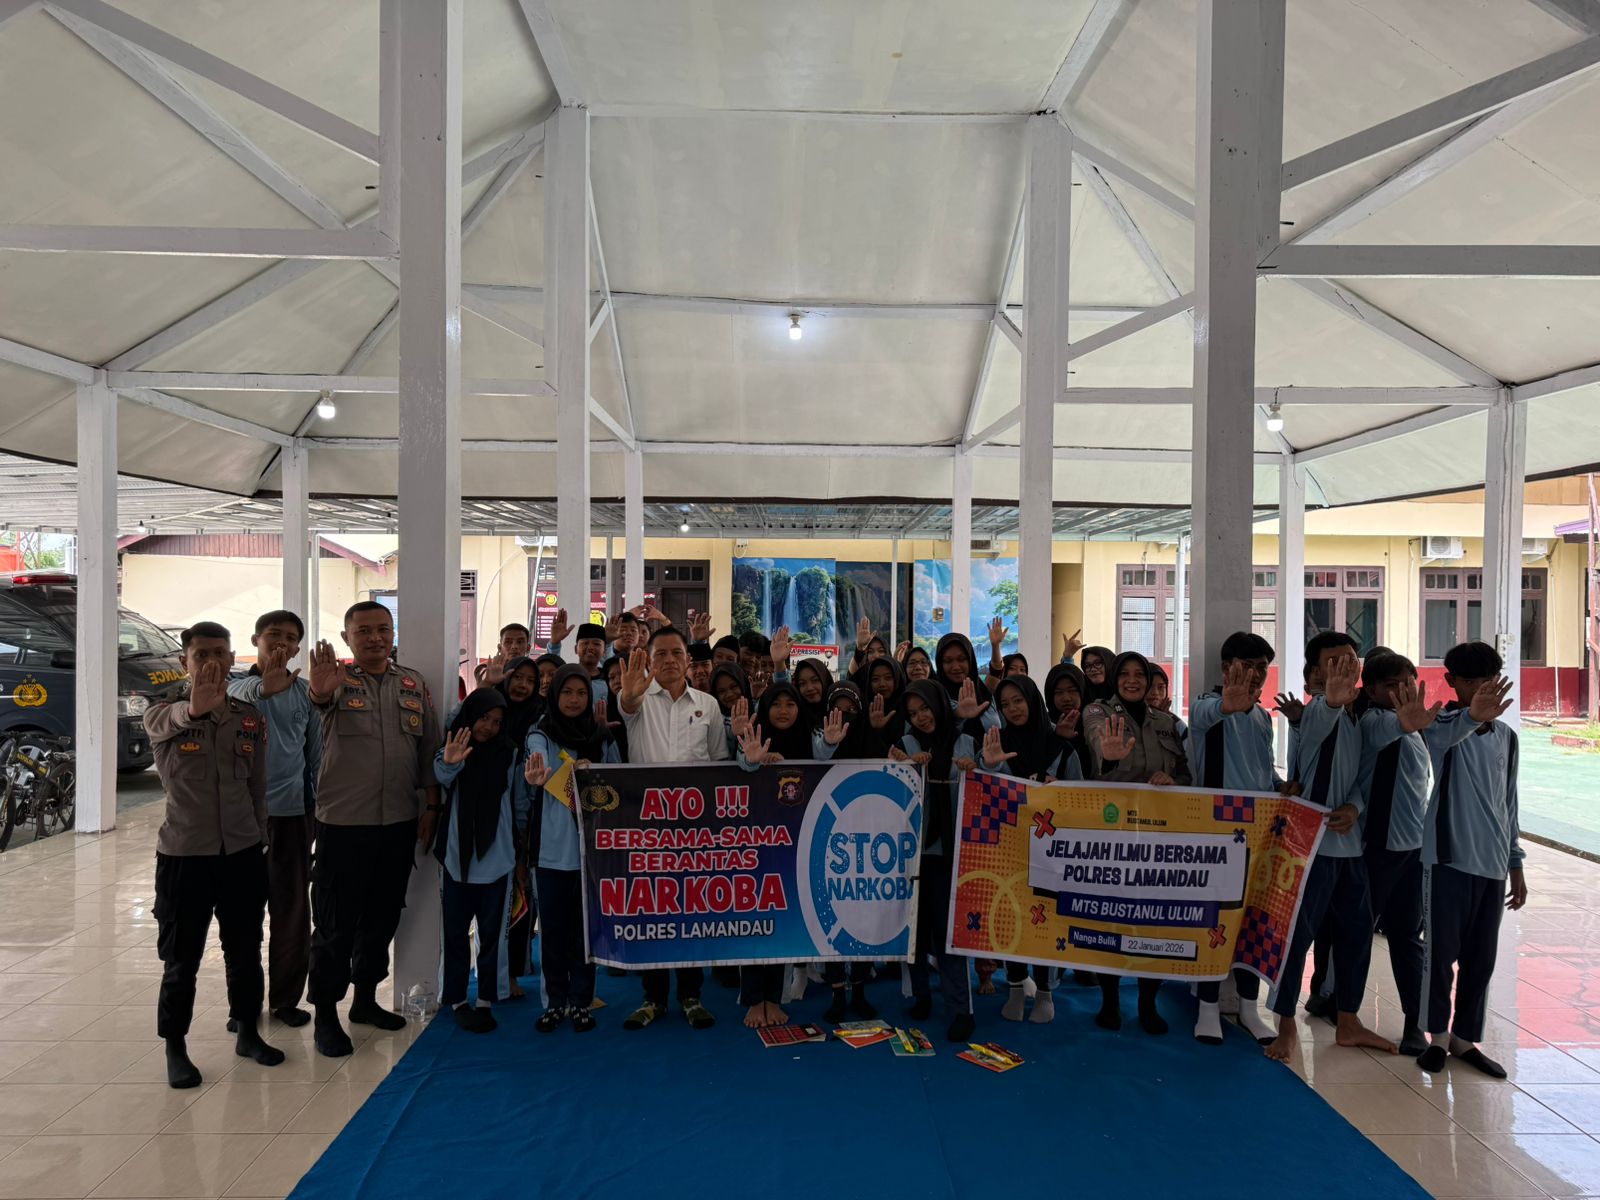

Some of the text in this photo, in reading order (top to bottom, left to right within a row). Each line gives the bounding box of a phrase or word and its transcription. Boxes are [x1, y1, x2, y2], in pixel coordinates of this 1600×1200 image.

[640, 785, 749, 820] AYO !!!
[596, 825, 792, 849] BERSAMA-SAMA
[629, 849, 758, 872] BERANTAS
[829, 832, 917, 874] STOP
[1046, 840, 1227, 864] JELAJAH ILMU BERSAMA
[1063, 864, 1209, 887] POLRES LAMANDAU
[600, 873, 787, 916] NARKOBA
[1071, 898, 1204, 921] MTS BUSTANUL ULUM
[614, 919, 774, 941] POLRES LAMANDAU
[1073, 931, 1117, 947] Nanga Bulik
[1128, 940, 1184, 953] 22 Januari 2026
